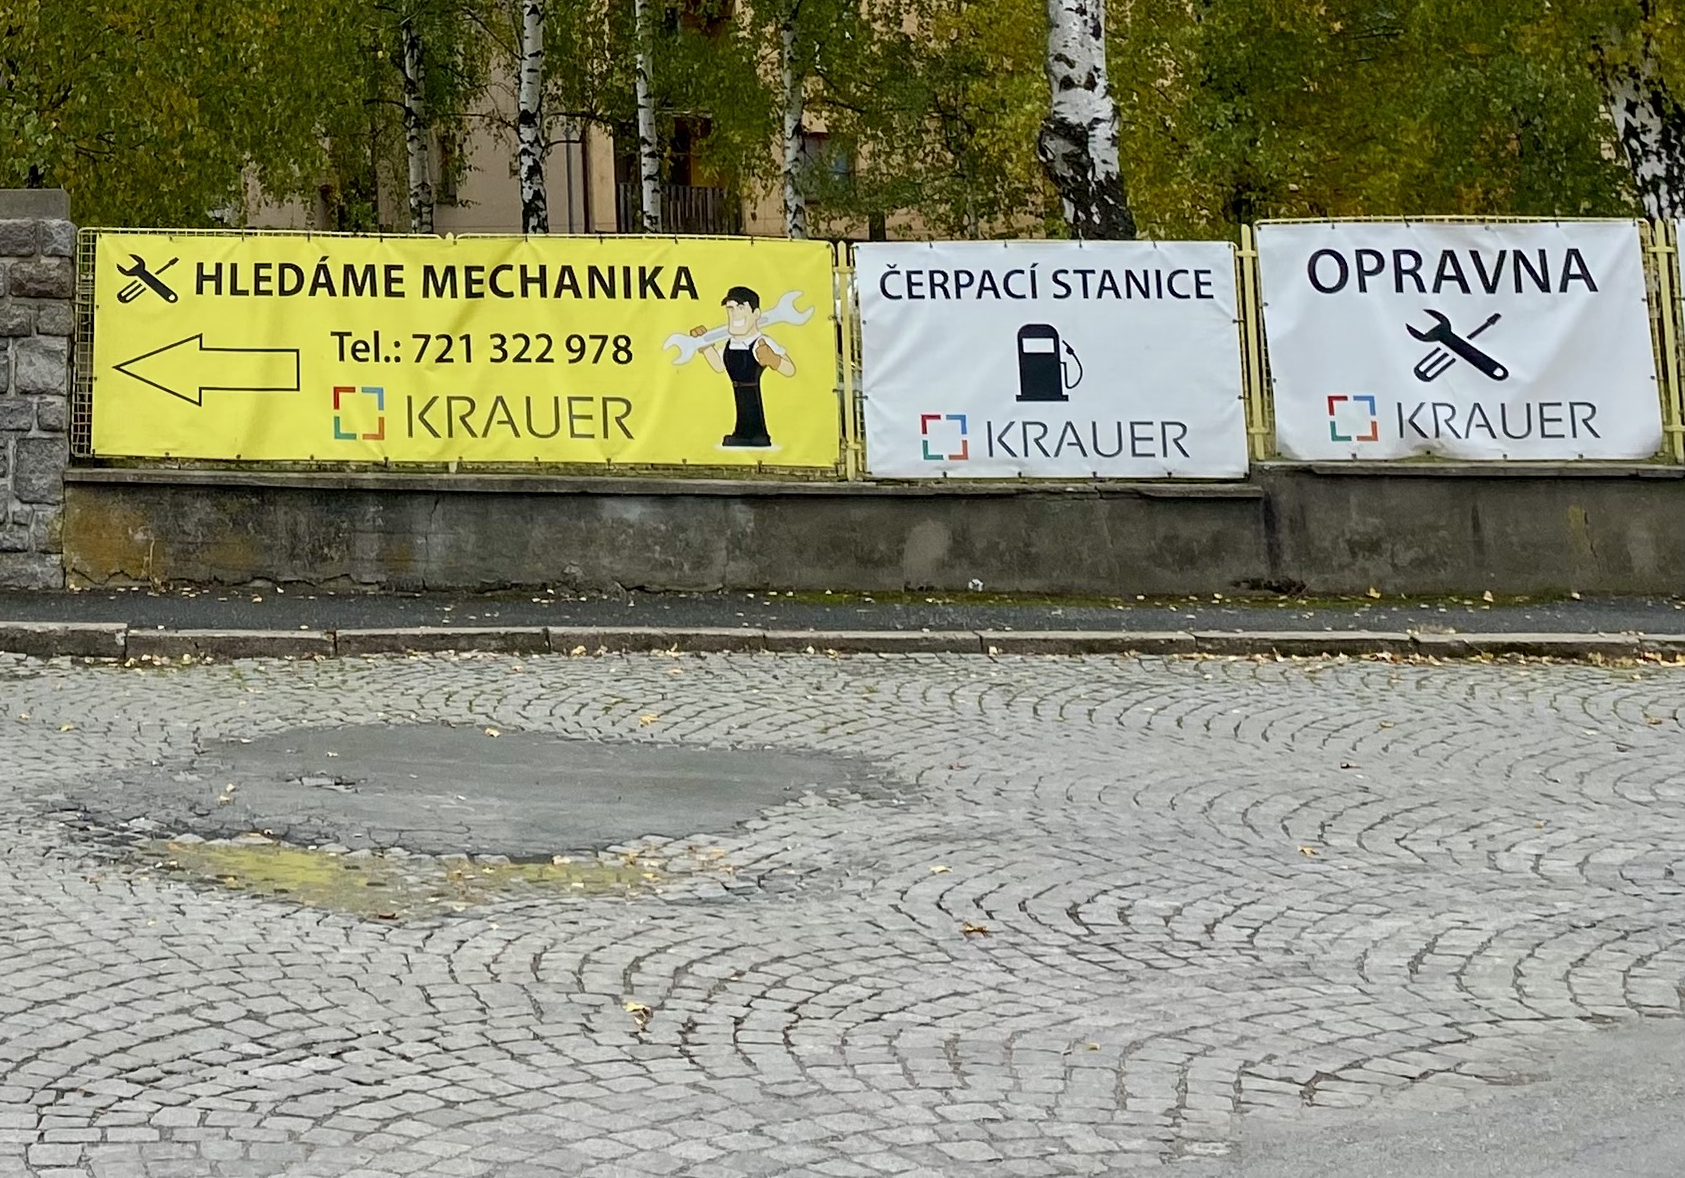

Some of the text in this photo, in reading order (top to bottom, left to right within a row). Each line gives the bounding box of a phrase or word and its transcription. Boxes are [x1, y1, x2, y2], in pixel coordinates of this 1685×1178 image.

[195, 255, 700, 301] HLEDÁME MECHANIKA
[879, 263, 1215, 300] ČERPACÍ STANICE
[1307, 248, 1599, 294] OPRAVNA
[330, 330, 634, 365] Tel.: 721 322 978
[406, 394, 635, 440] KRAUER
[1396, 401, 1602, 440] KRAUER
[986, 420, 1191, 458] KRAUER
